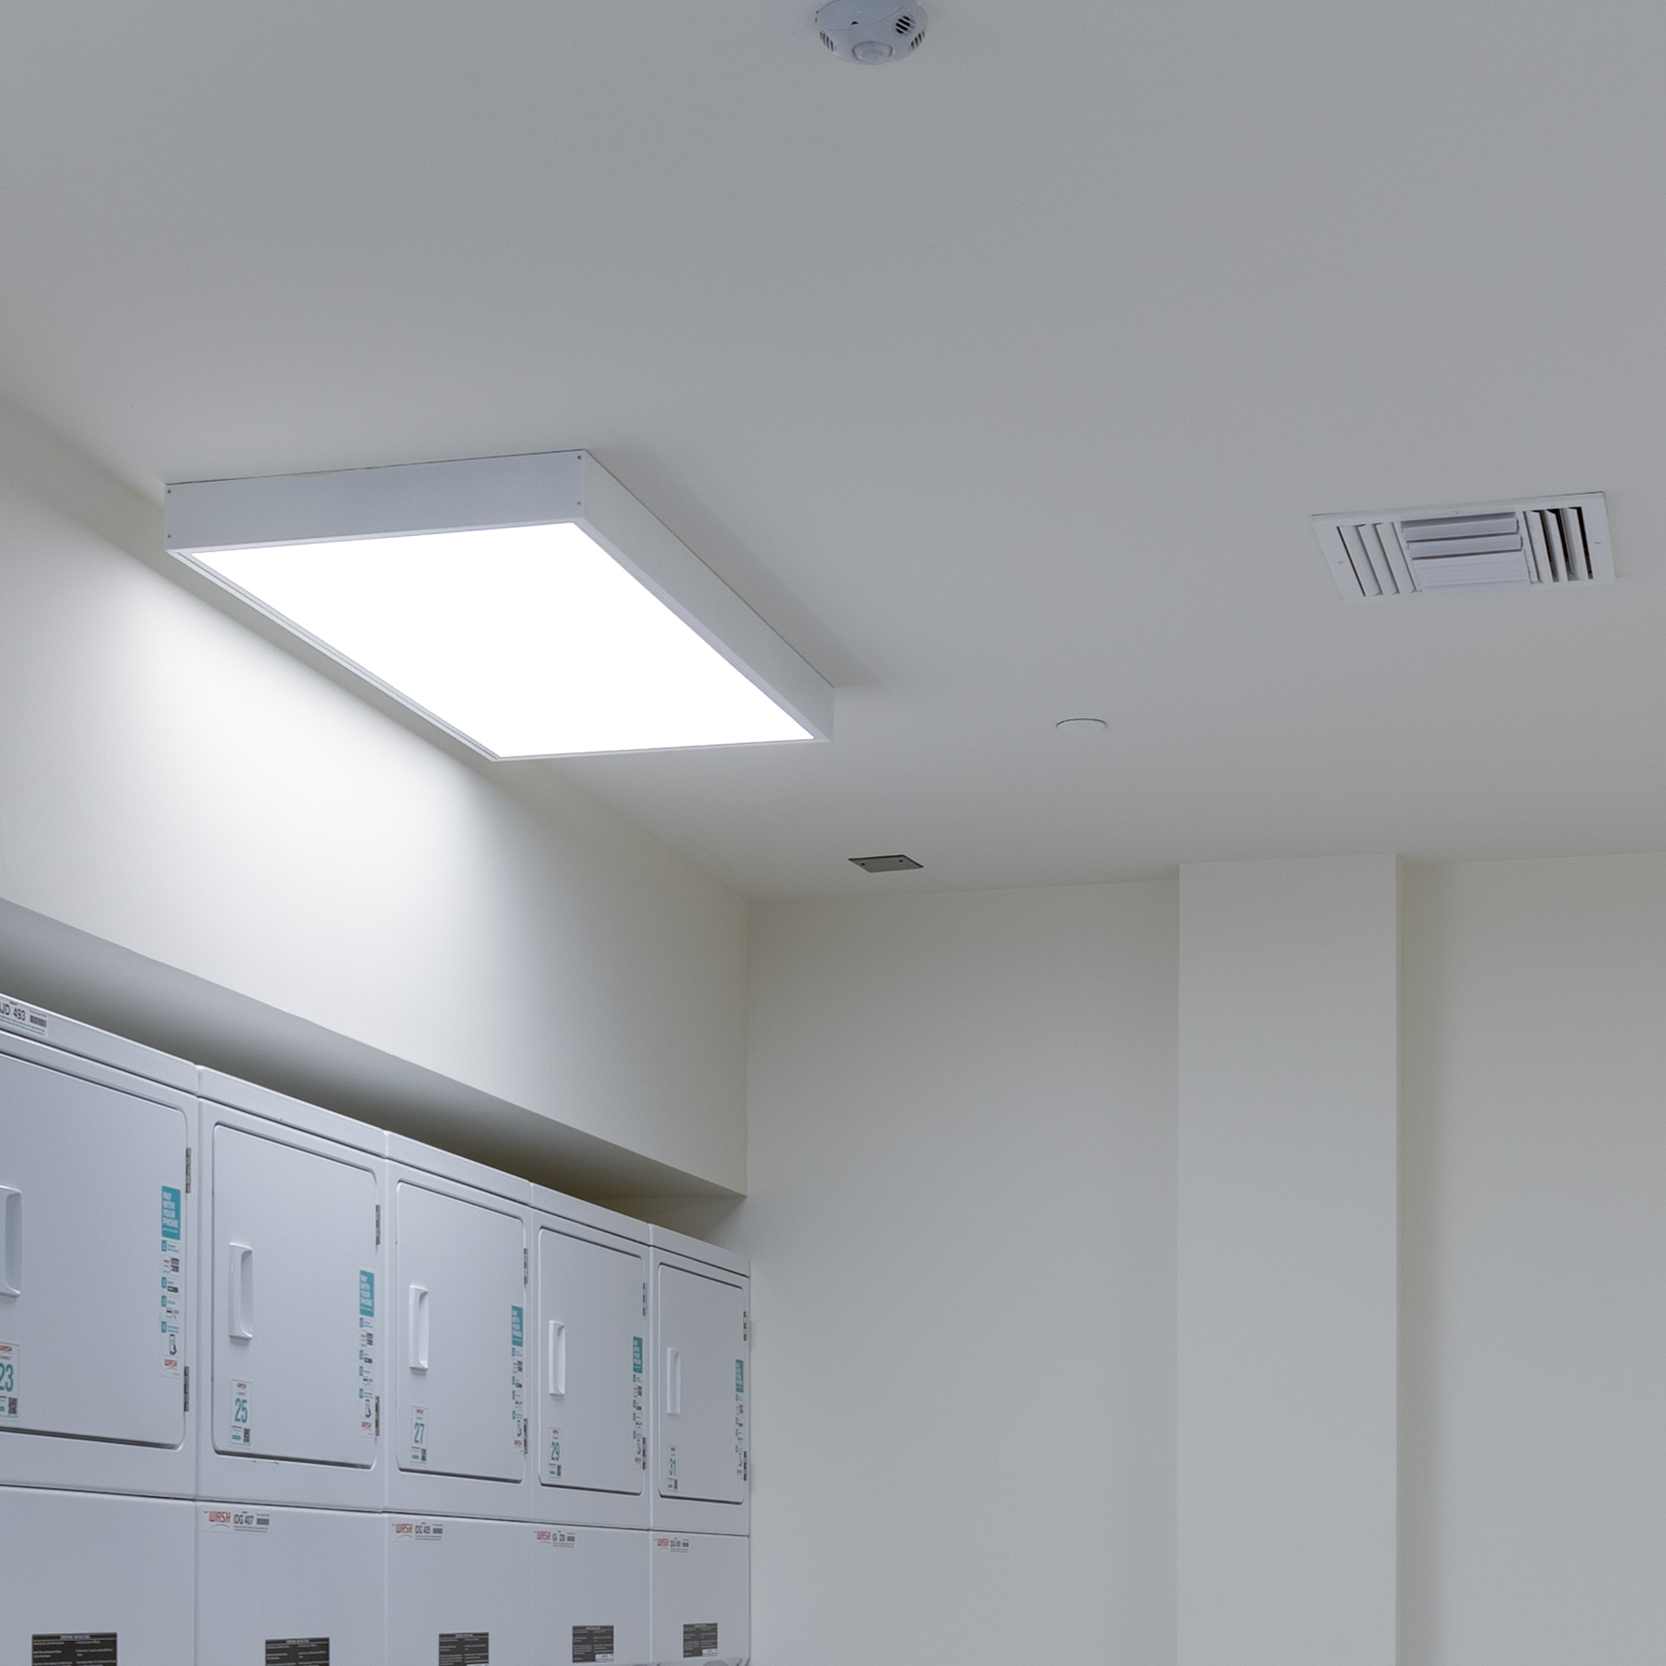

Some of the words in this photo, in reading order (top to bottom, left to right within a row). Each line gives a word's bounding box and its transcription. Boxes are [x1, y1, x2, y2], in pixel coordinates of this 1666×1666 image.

[234, 1397, 248, 1424] 25
[414, 1422, 425, 1444] 27
[209, 1511, 232, 1523] WASH
